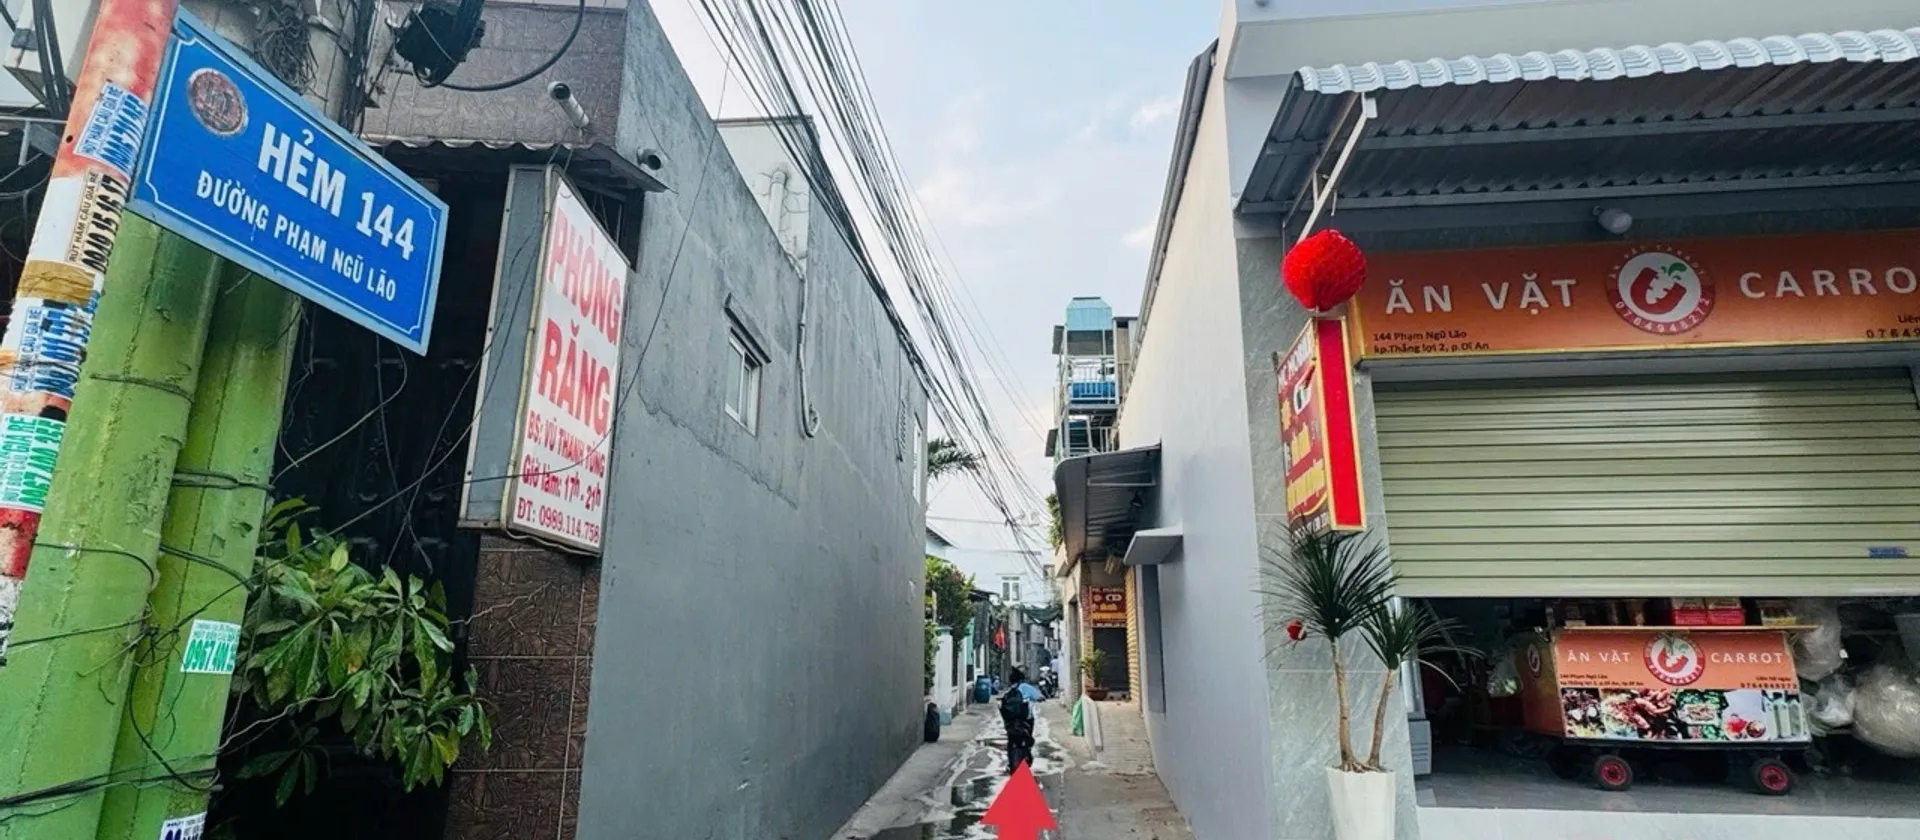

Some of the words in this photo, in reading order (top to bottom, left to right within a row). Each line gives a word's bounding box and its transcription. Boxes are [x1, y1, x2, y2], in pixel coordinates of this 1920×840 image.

[258, 122, 346, 218] HẺM
[356, 191, 415, 261] 144
[196, 169, 270, 231] ĐƯỜNG
[274, 213, 327, 260] PHẠM
[332, 247, 364, 285] NGŨ
[366, 267, 396, 301] LÃO
[547, 207, 621, 345] PHÒNG
[1385, 278, 1453, 315] ĂN
[1481, 272, 1577, 316] VẶT
[1739, 266, 1918, 299] CARRO
[1373, 332, 1391, 342] 144
[1394, 331, 1424, 343] Phạm
[1426, 330, 1446, 342] Ngũ
[1448, 328, 1468, 339] Lão
[1474, 341, 1490, 351] An
[538, 317, 611, 436] RĂNG
[527, 410, 542, 445] BS:
[521, 454, 540, 488] Giờ
[517, 497, 536, 523] ĐT:
[1567, 649, 1591, 663] ĂN
[1598, 648, 1631, 665] VẶT
[1710, 652, 1783, 664] CARROT
